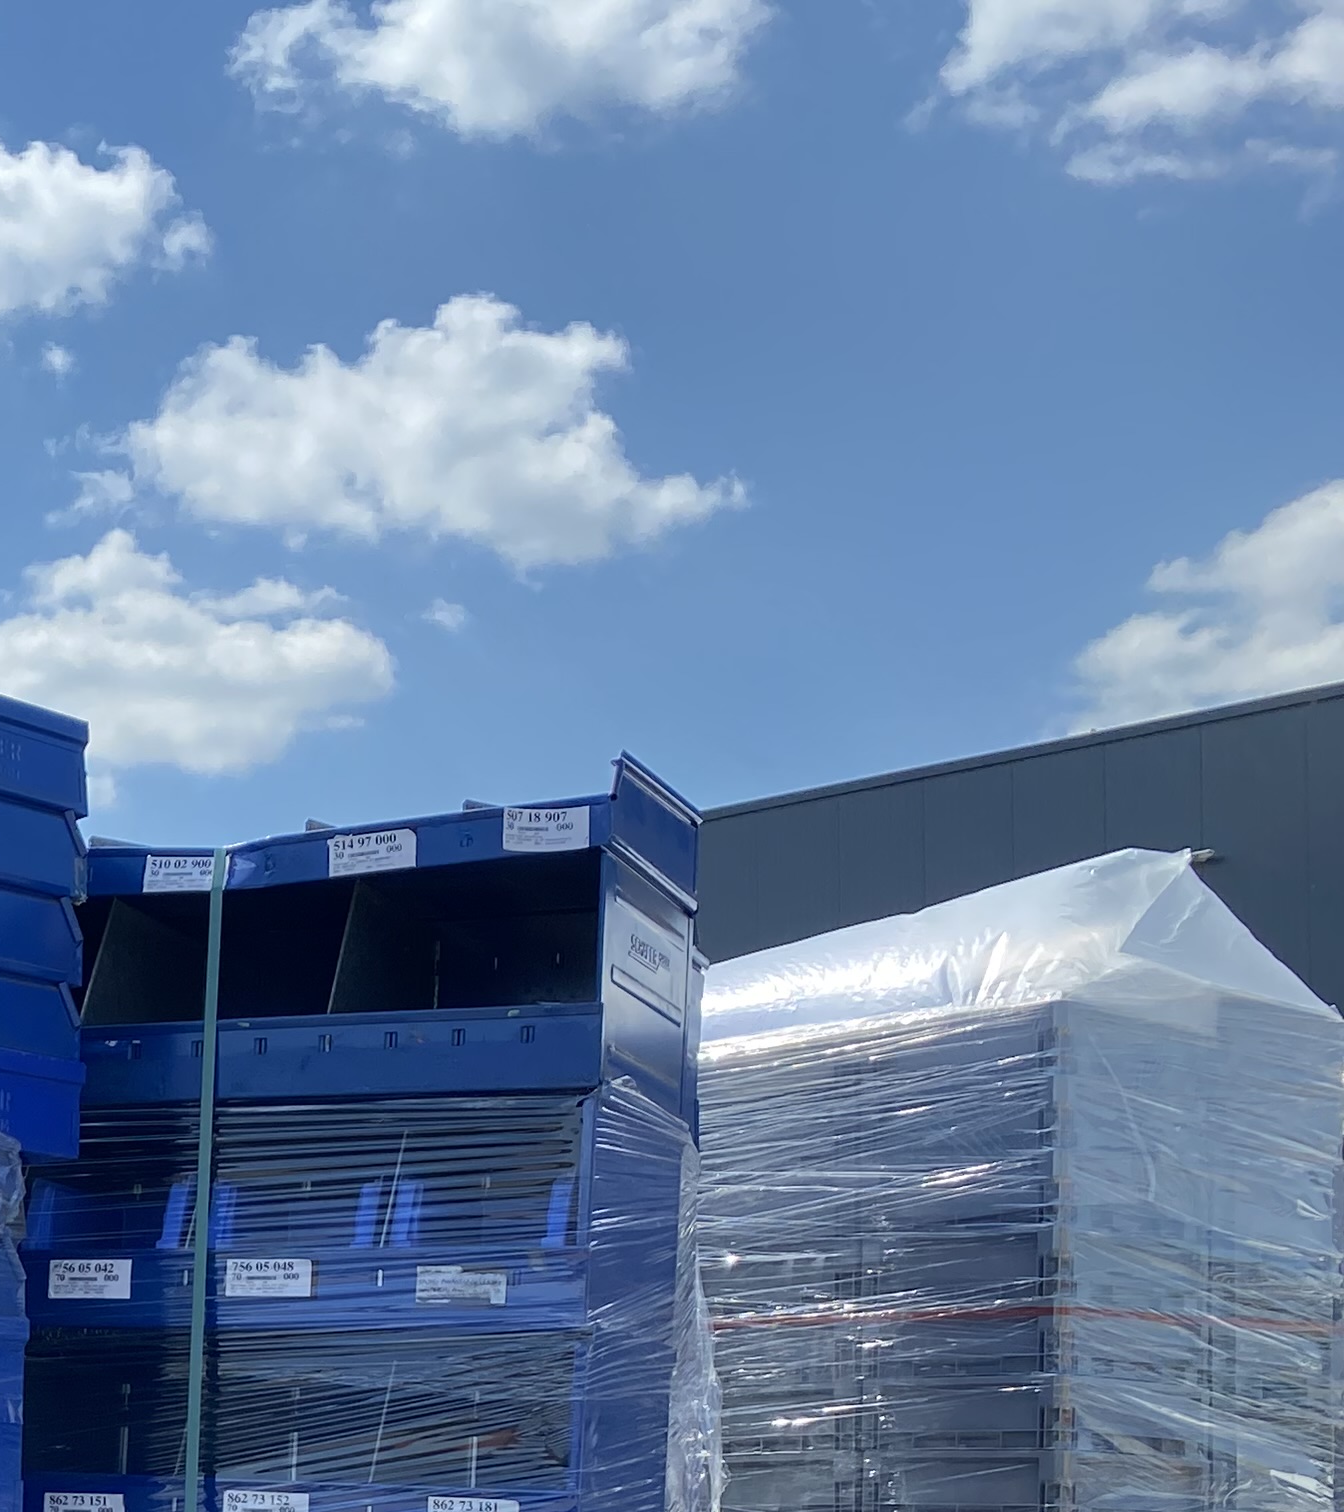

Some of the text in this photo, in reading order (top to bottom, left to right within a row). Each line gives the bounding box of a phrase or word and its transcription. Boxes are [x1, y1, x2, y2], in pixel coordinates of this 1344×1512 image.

[506, 809, 567, 822] 507 18 907
[556, 822, 573, 831] 000
[333, 833, 397, 851] 514 97 000
[334, 844, 402, 860] 30 000
[150, 858, 212, 870] 510 02 900
[78, 1263, 92, 1274] 05
[95, 1263, 114, 1274] 042
[232, 1261, 294, 1272] 756 05 048
[55, 1274, 119, 1282] 70 000
[232, 1273, 299, 1281] 70 000
[49, 1494, 107, 1506] 862 73 151
[227, 1493, 290, 1506] 862 73 152
[433, 1499, 498, 1512] 862 73 181
[227, 1504, 238, 1512] 70
